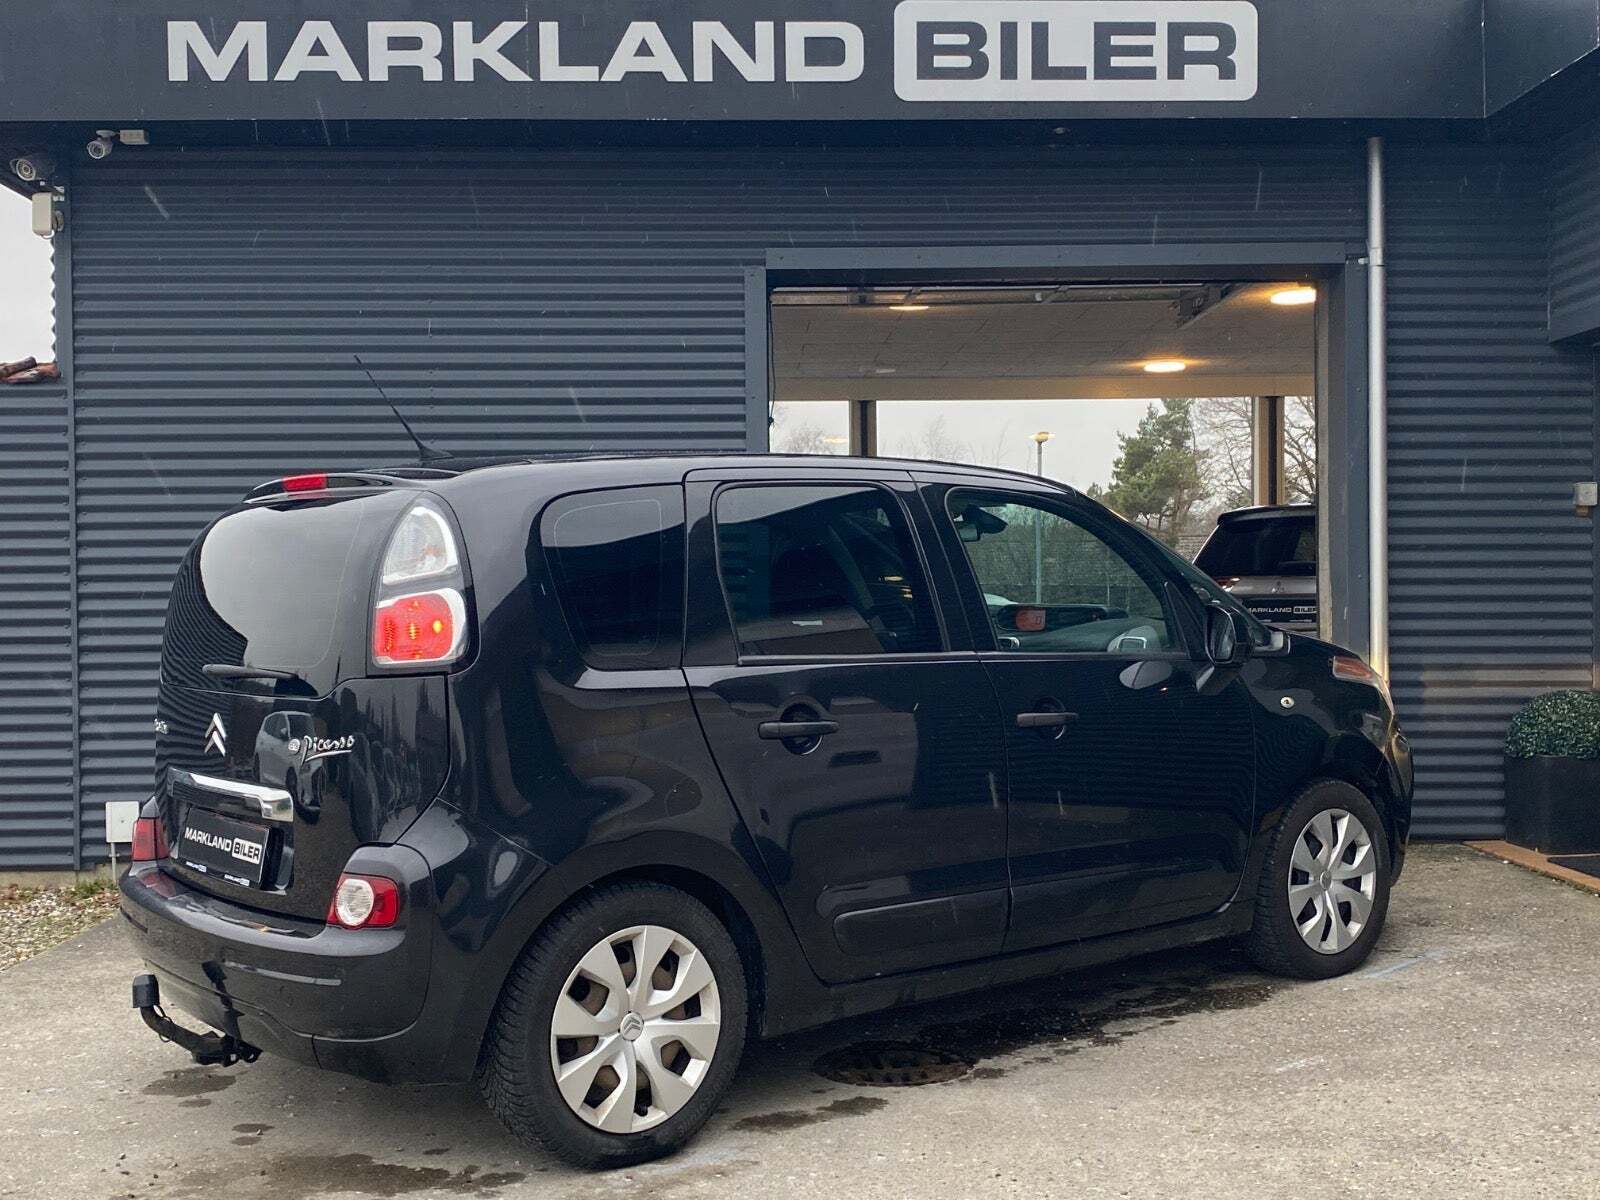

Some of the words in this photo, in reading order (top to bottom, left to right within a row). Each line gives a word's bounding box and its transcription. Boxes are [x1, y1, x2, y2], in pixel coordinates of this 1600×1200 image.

[168, 21, 864, 82] MARKLAND
[916, 21, 1236, 80] BILER
[301, 735, 355, 767] Picasso
[184, 827, 232, 852] MARKLAND
[234, 841, 261, 861] BILER
